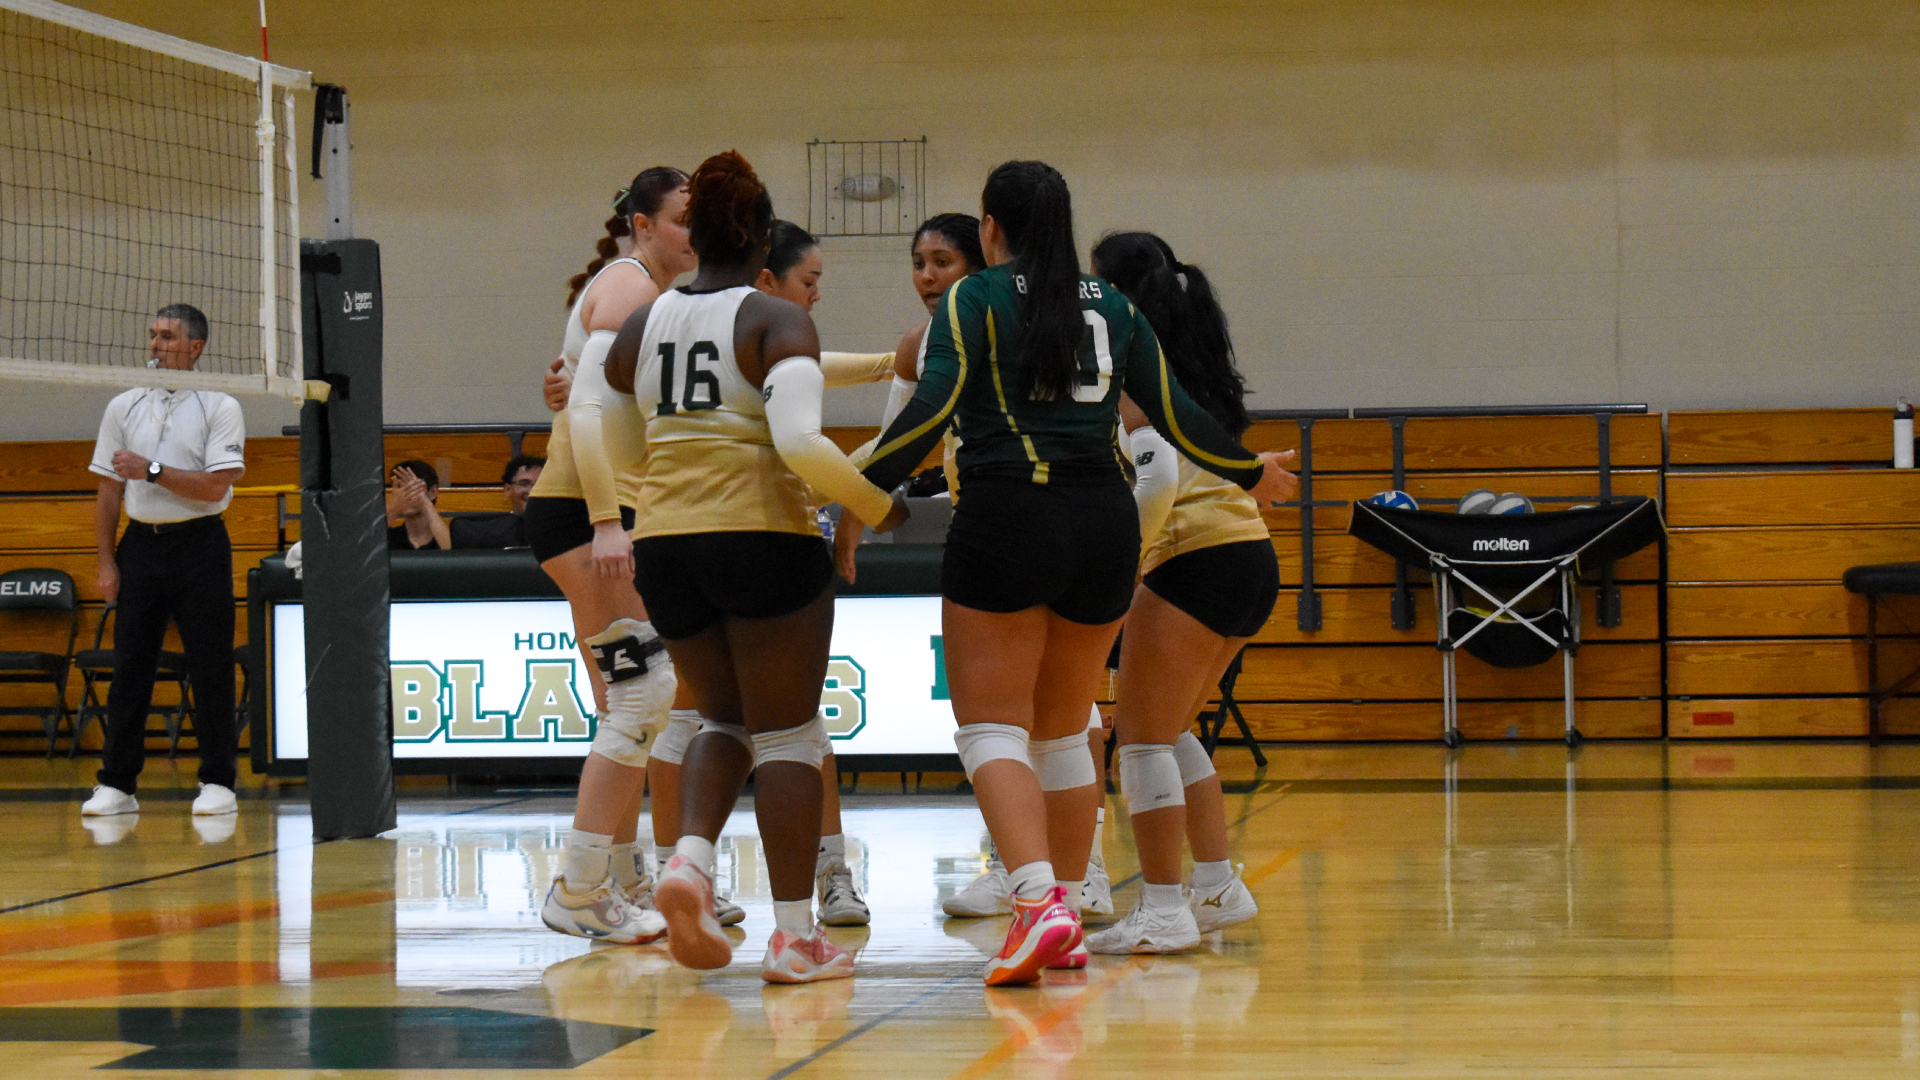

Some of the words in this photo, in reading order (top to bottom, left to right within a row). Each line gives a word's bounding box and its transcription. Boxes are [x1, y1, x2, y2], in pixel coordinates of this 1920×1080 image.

[657, 340, 722, 415] 16
[1473, 537, 1530, 551] molten
[0, 581, 62, 595] ELMS
[514, 632, 577, 650] HOM
